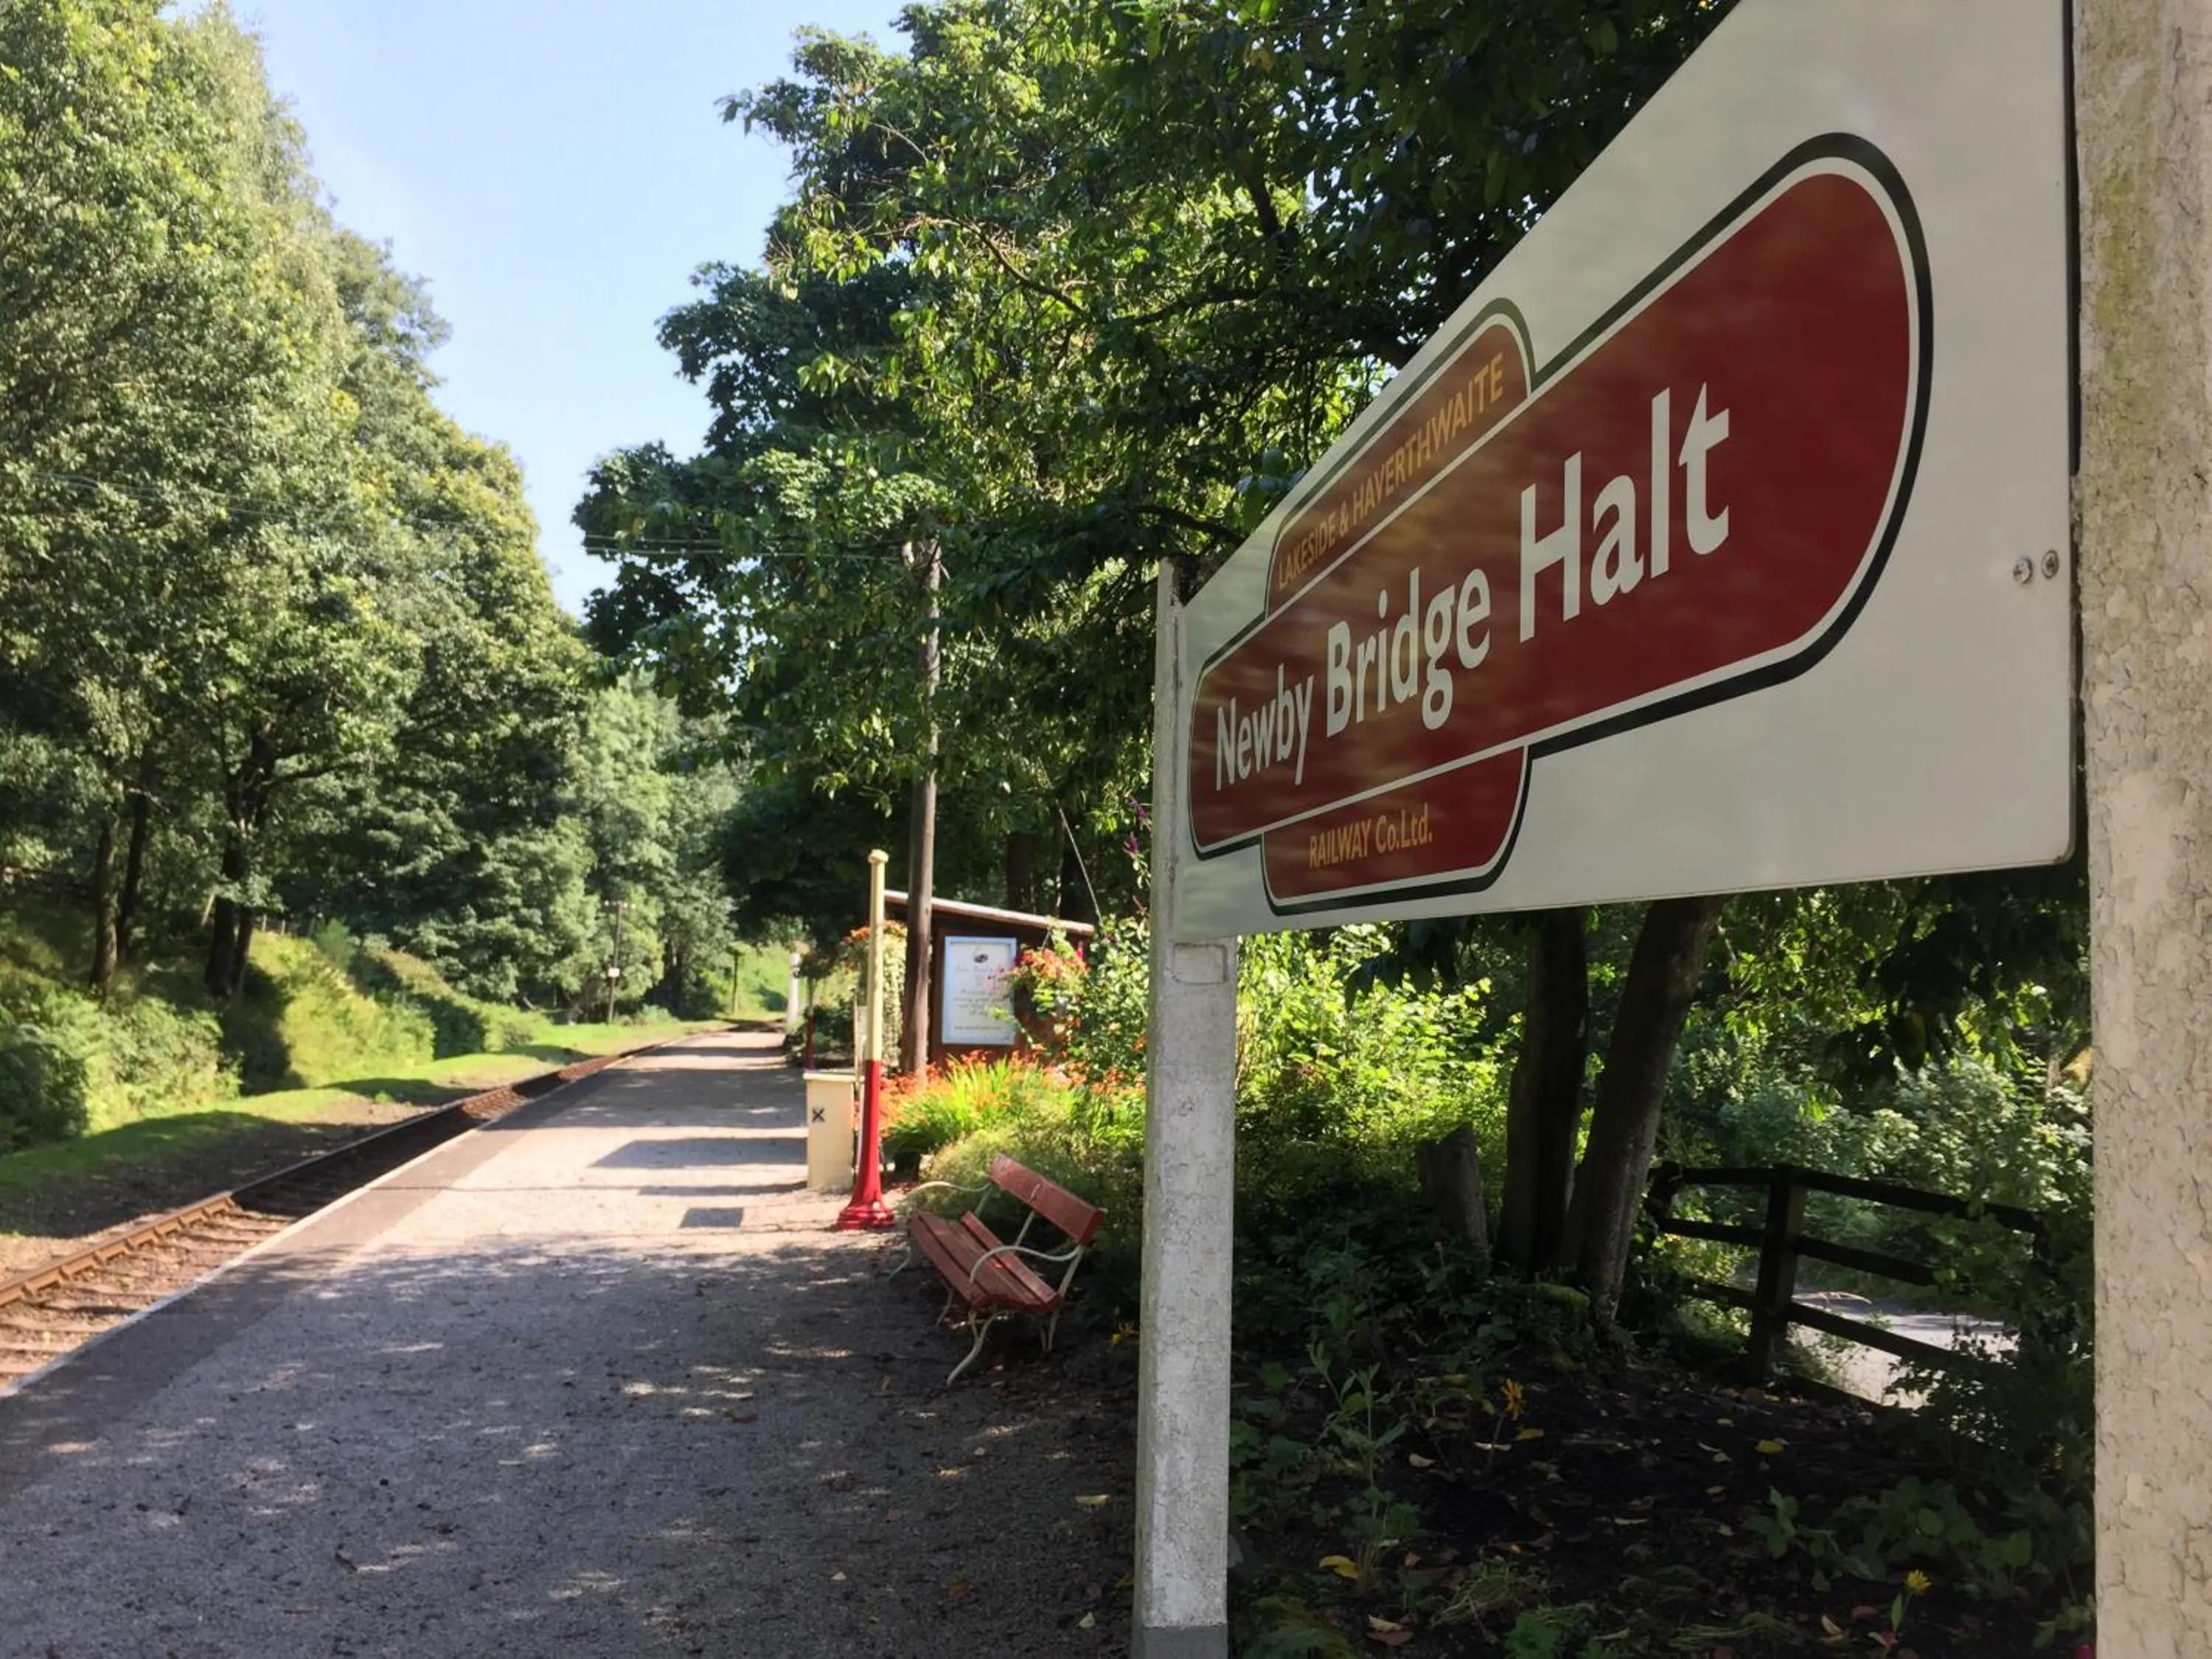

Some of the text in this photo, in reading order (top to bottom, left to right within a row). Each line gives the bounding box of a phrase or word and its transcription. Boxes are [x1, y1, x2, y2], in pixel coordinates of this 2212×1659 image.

[1215, 381, 1730, 791] Newby Bridge Halt
[1279, 352, 1504, 591] LAKESIDE & HAVERTHWAITE
[1309, 818, 1371, 869] RAILWAY
